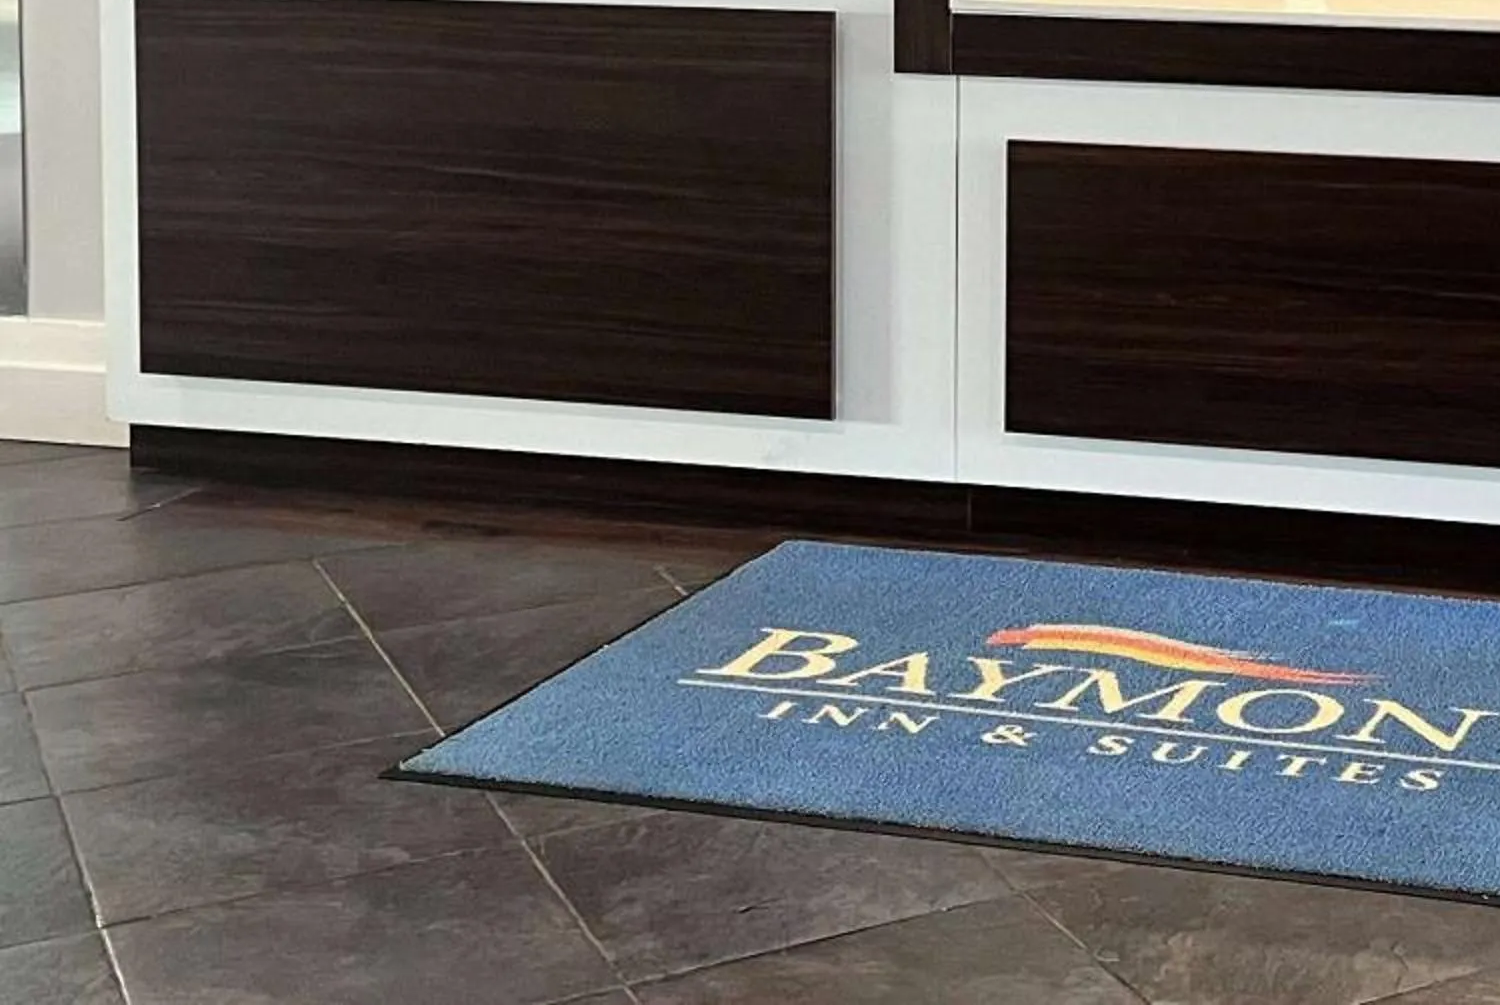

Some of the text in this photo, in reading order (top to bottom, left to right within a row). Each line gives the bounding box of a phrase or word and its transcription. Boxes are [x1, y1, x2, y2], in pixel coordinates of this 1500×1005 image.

[756, 701, 1445, 791] INN & SUITES
